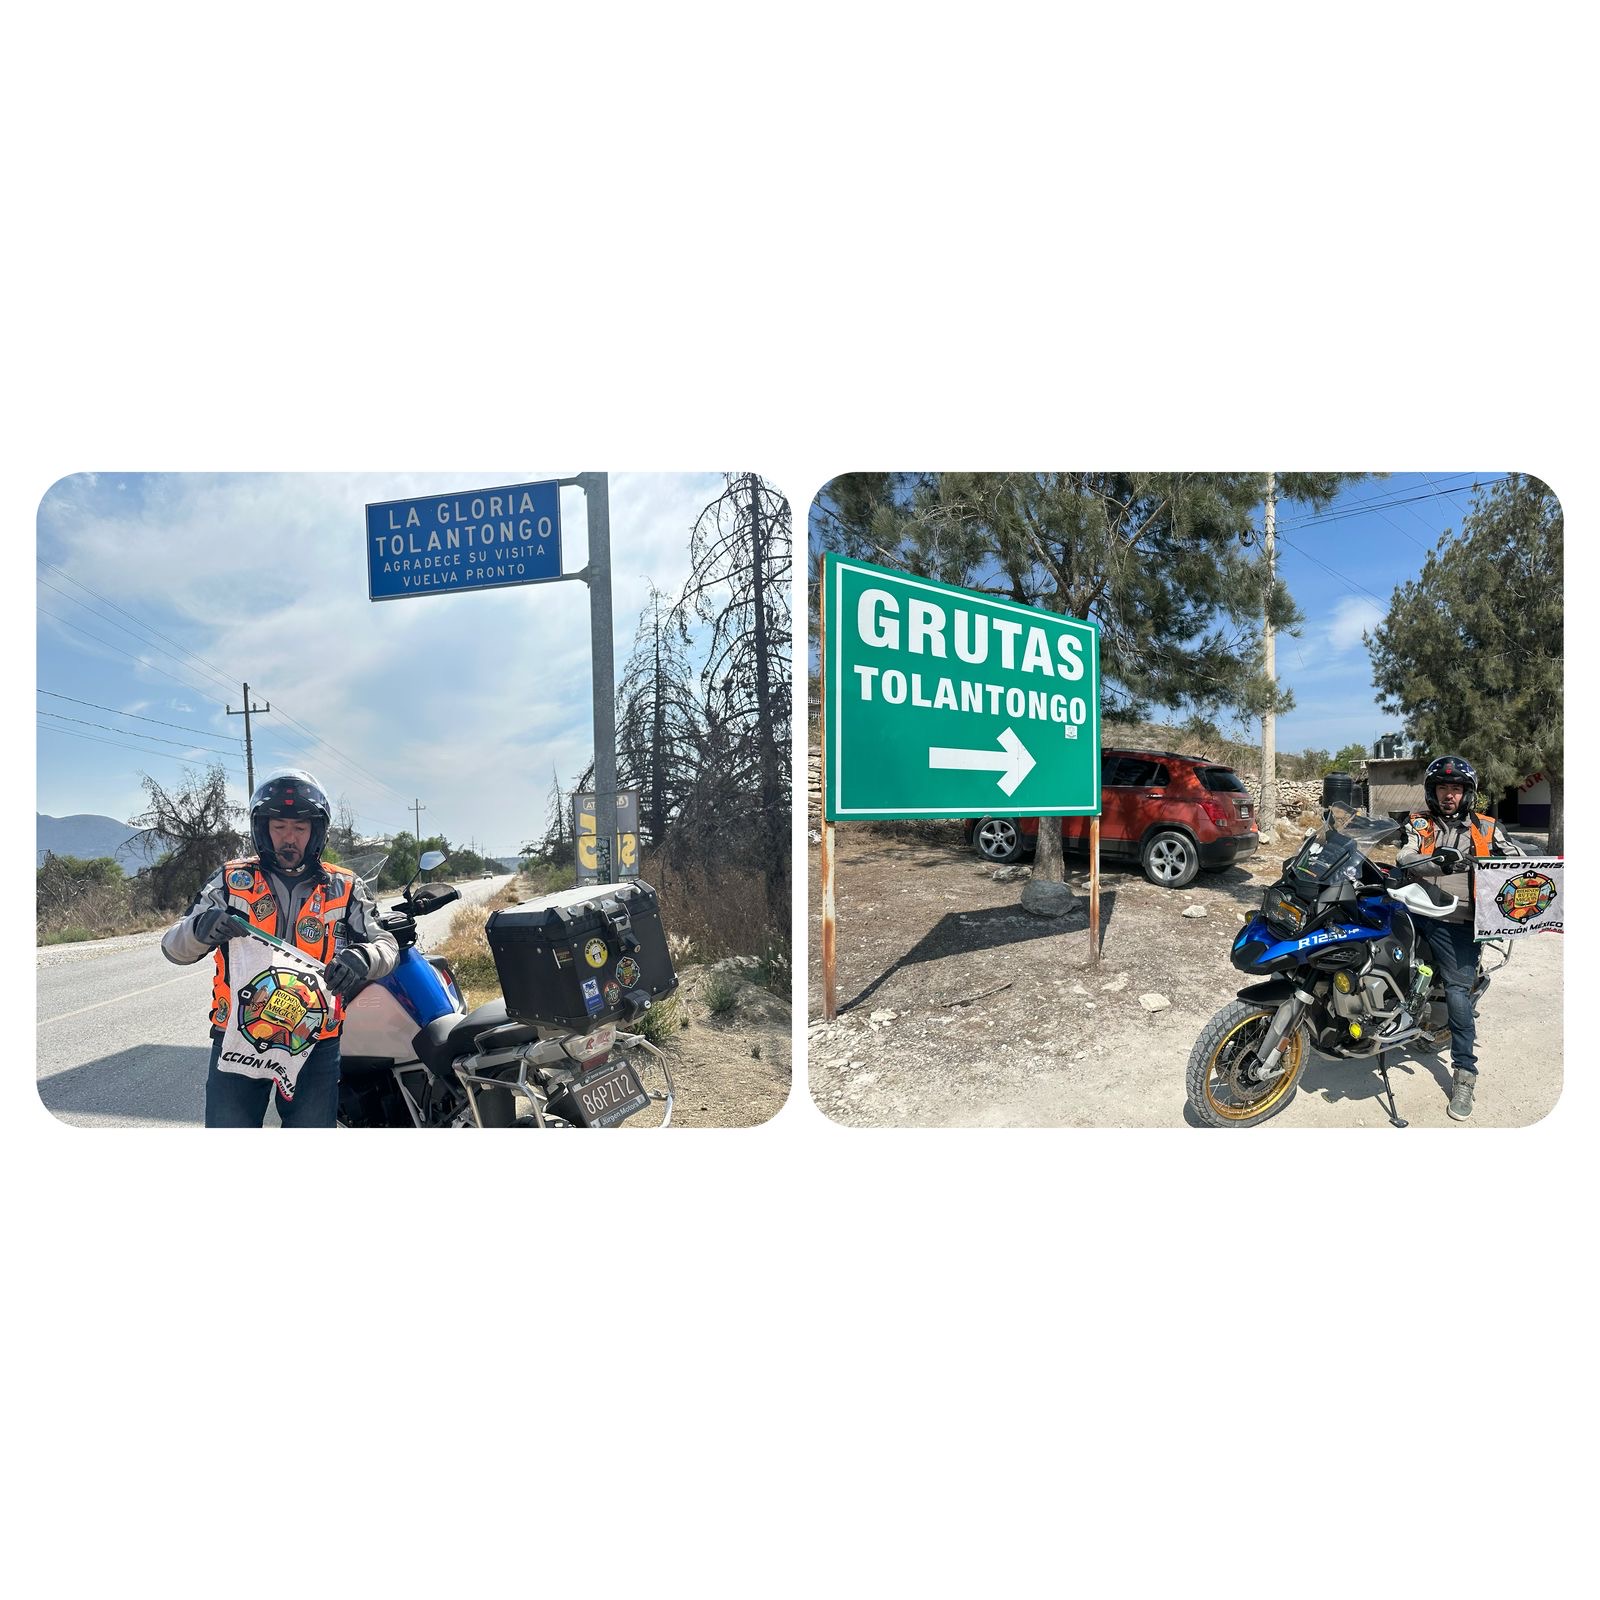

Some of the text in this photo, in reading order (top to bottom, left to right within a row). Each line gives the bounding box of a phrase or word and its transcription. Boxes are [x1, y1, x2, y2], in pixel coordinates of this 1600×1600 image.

[389, 492, 535, 530] LA GLORIA
[375, 516, 552, 557] TOLANTONGO
[384, 544, 545, 573] AGRADECE SU VISITA
[403, 564, 525, 587] VUELVA PRONTO
[857, 588, 1085, 681] GRUTAS
[854, 664, 1086, 725] TOLANTONGO
[1477, 861, 1563, 870] MOTOTURIS
[1494, 926, 1528, 935] ACCIÓN
[1530, 920, 1563, 931] MÉXICO
[303, 975, 315, 986] N
[241, 989, 252, 999] O
[259, 1041, 269, 1050] S
[582, 1074, 635, 1115] 86PZT2
